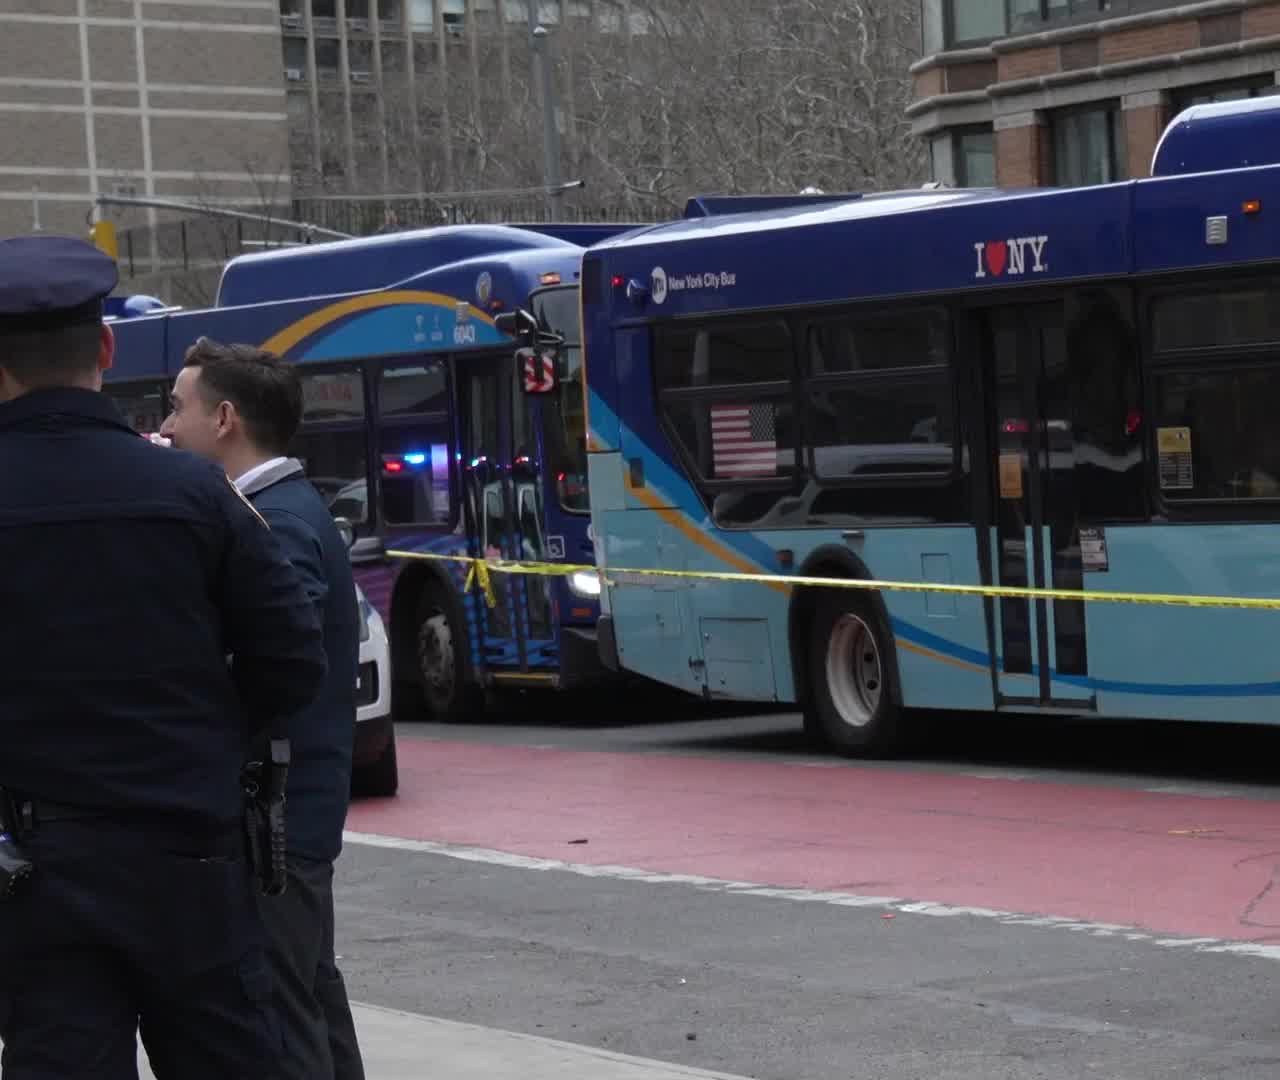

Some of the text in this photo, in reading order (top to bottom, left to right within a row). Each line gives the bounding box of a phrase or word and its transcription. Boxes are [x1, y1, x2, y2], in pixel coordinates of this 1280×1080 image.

[974, 235, 1048, 277] I NY
[668, 271, 737, 291] New York City Bus
